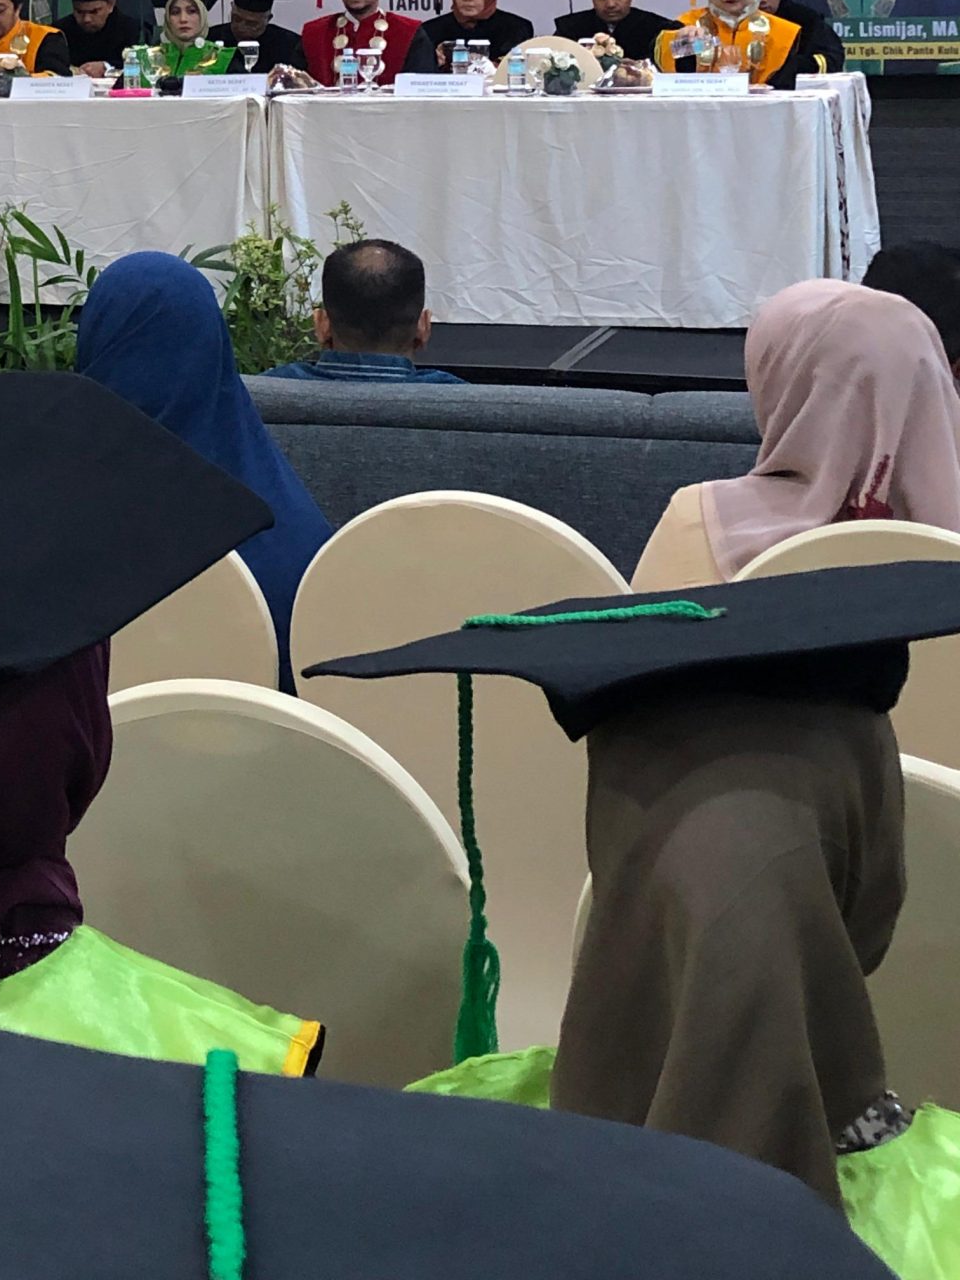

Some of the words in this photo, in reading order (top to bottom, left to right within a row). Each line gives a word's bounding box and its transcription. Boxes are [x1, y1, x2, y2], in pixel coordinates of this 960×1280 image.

[833, 22, 854, 37] Dr.
[859, 21, 927, 40] Lismijar,
[932, 21, 958, 36] MA
